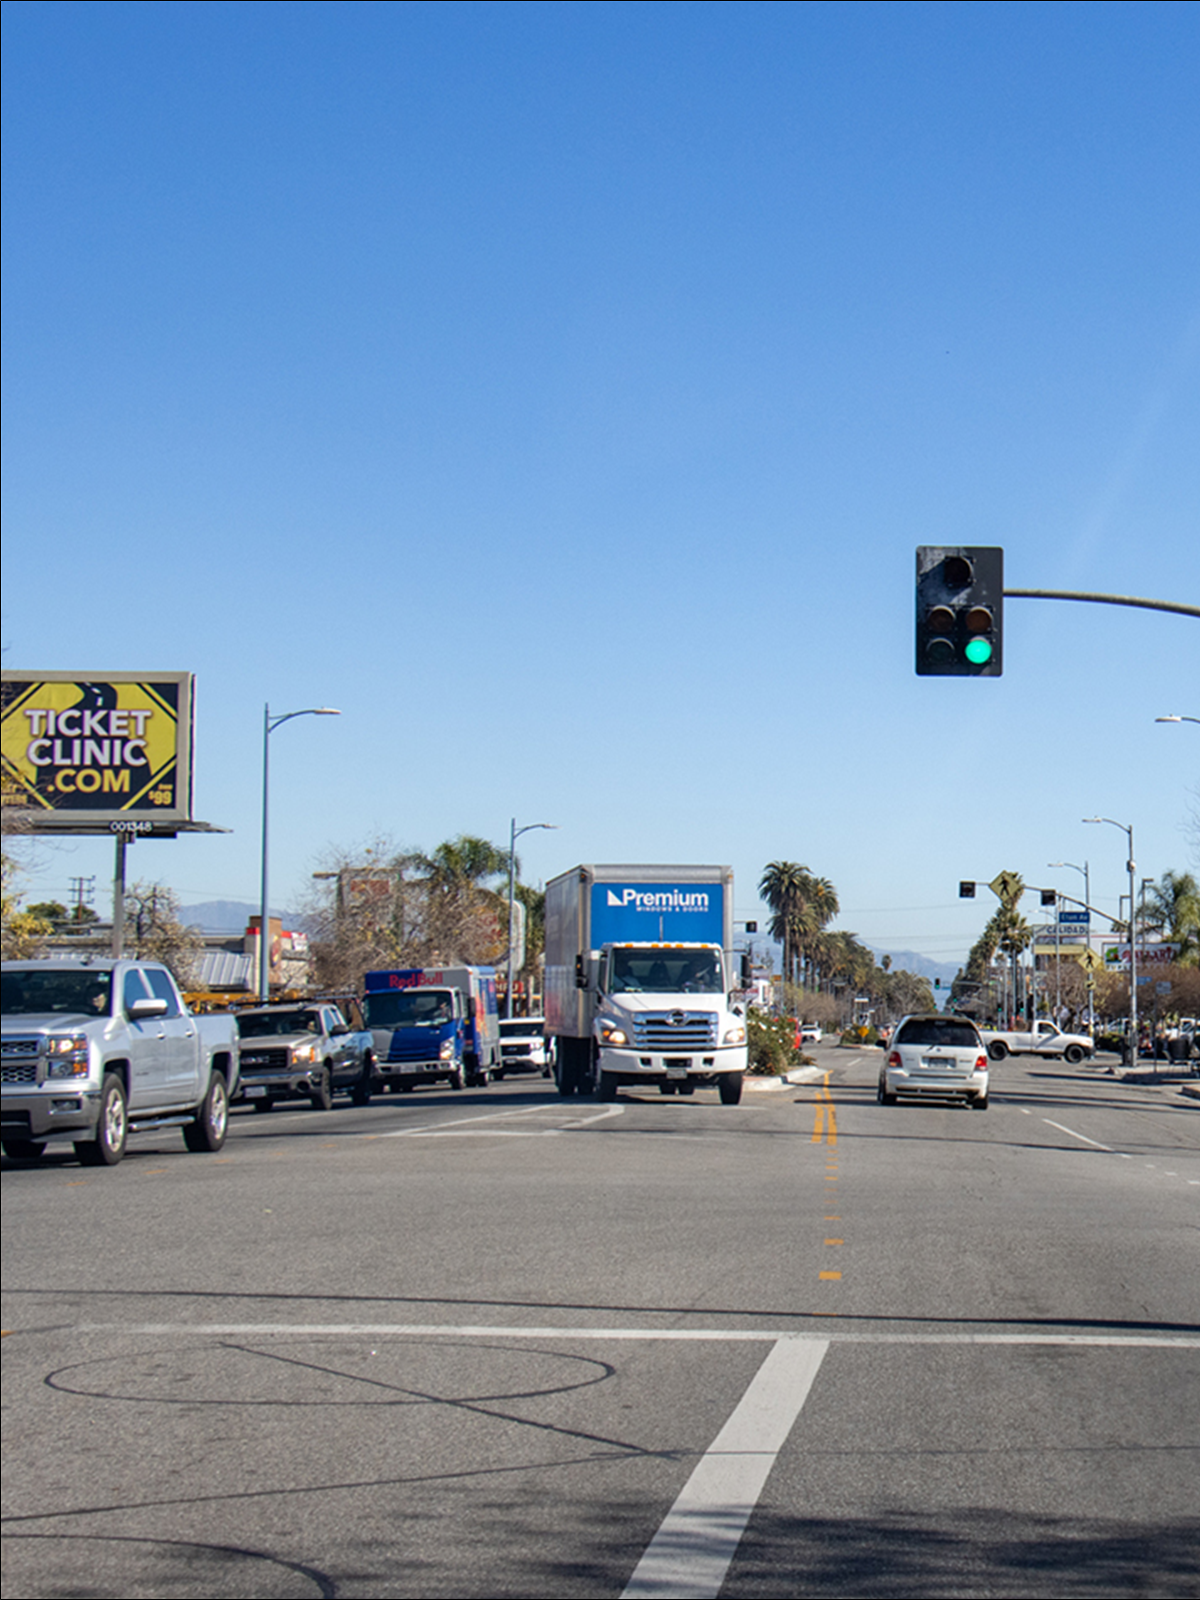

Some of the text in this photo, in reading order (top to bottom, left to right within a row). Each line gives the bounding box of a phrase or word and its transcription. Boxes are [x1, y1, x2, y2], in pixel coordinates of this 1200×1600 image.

[24, 709, 152, 737] TICKET
[26, 738, 148, 767] CLINIC
[46, 768, 131, 793] .COM
[623, 889, 709, 906] Premium
[389, 972, 443, 988] Red Bull
